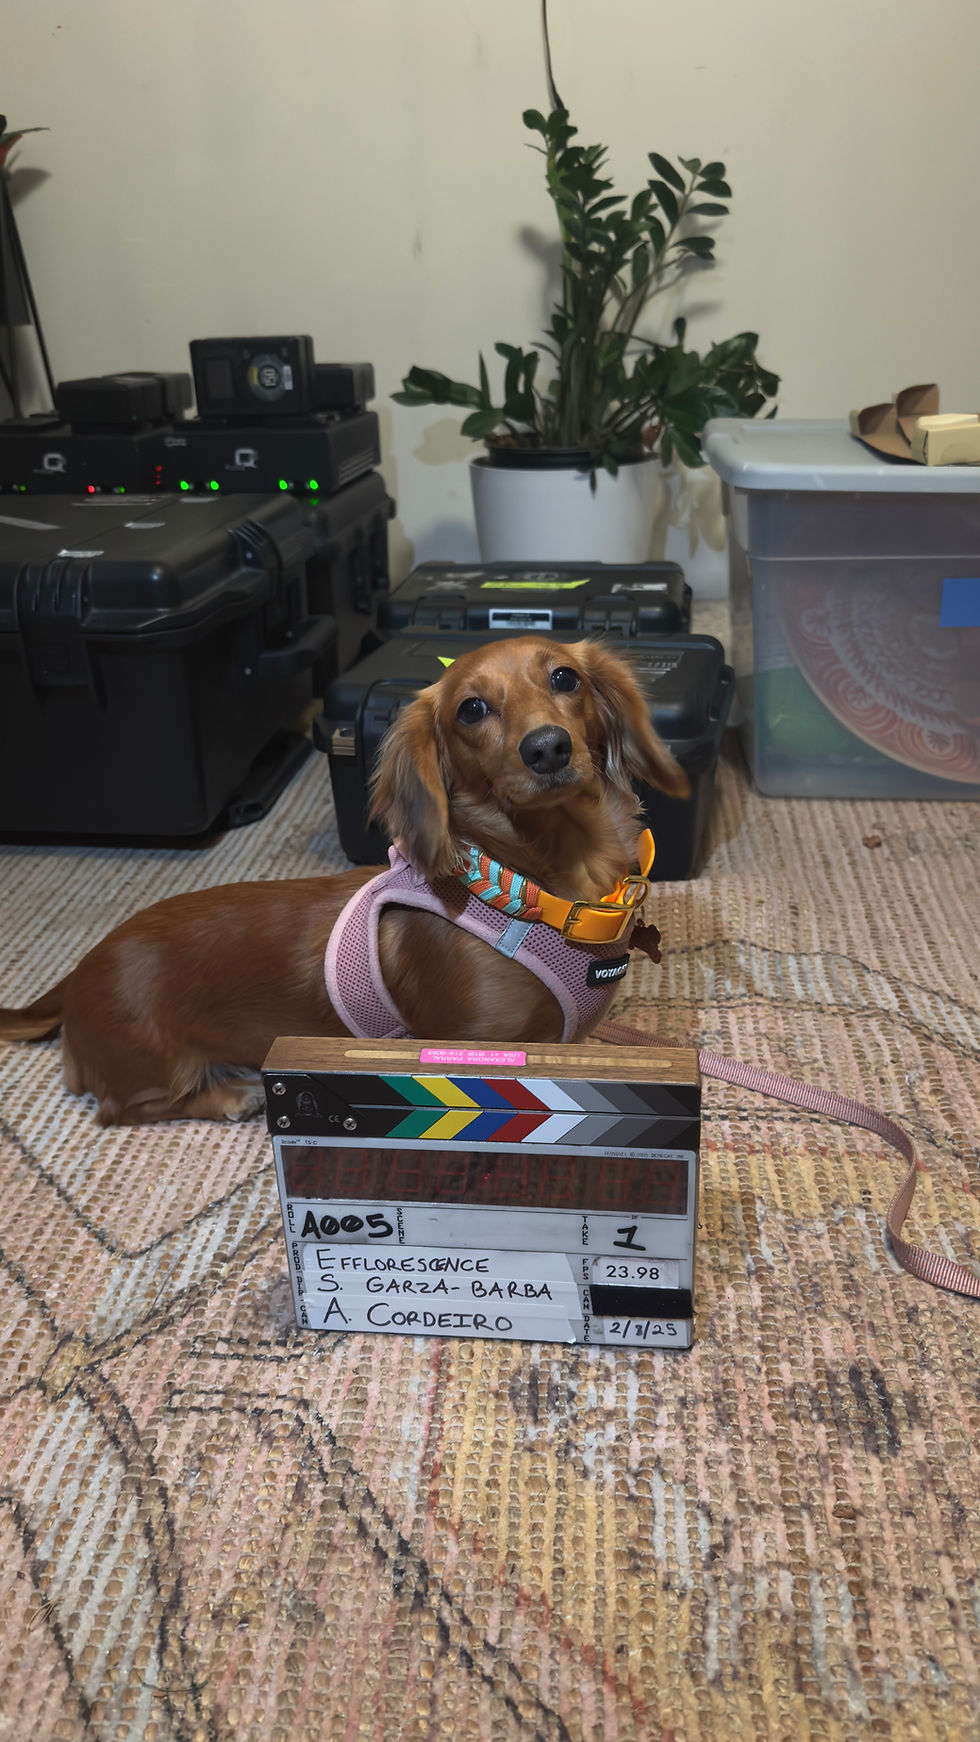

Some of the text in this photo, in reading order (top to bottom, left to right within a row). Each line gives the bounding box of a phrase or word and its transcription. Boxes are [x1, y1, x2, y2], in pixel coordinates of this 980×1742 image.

[286, 1203, 296, 1233] ROLL
[396, 1207, 405, 1244] SCENE
[613, 1225, 647, 1251] 1
[292, 1242, 301, 1270] PROD
[582, 1258, 590, 1280] FPS
[317, 1273, 343, 1292] S.
[606, 1265, 660, 1280] 23.98
[300, 1305, 309, 1325] CAM
[323, 1296, 513, 1331] A. CORDEIRO
